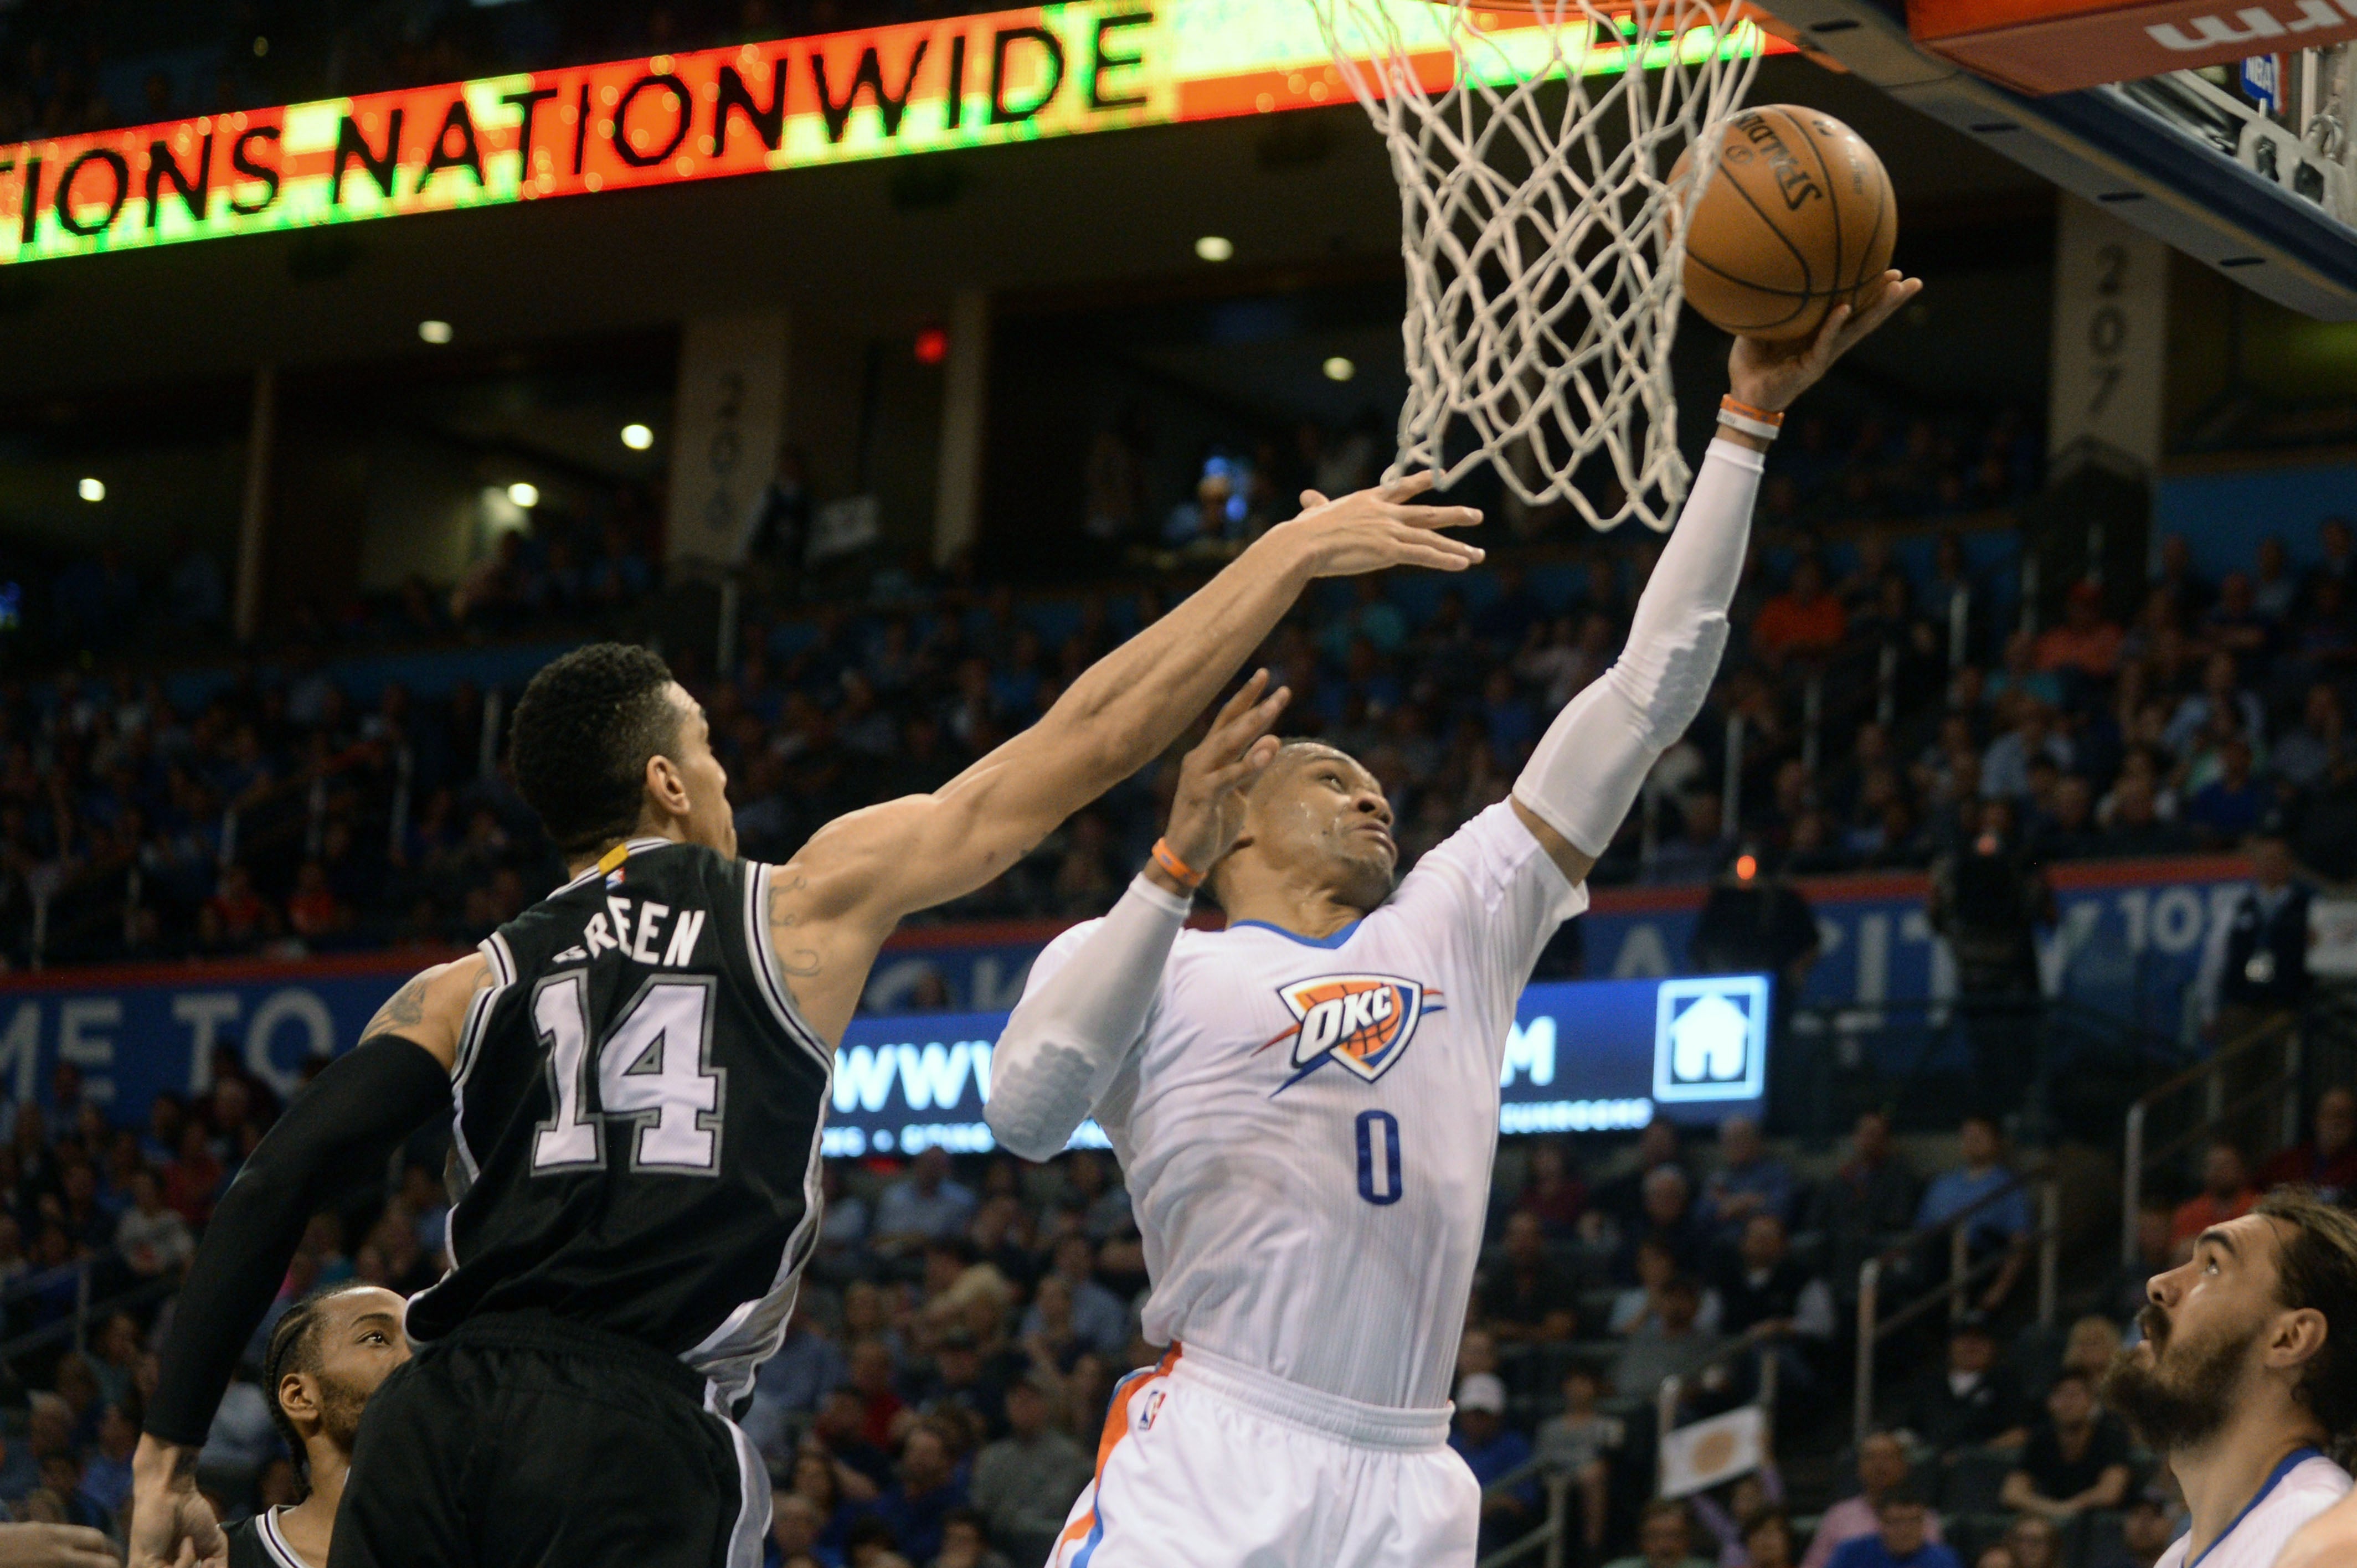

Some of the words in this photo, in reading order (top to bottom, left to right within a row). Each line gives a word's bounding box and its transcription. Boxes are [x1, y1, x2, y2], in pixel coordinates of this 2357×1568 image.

[0, 126, 281, 244] IONS
[332, 12, 1154, 205] NATIONWIDE
[171, 988, 335, 1103] TO
[529, 968, 727, 1177] 14
[1293, 985, 1393, 1067] OKC
[1355, 1110, 1402, 1205] 0
